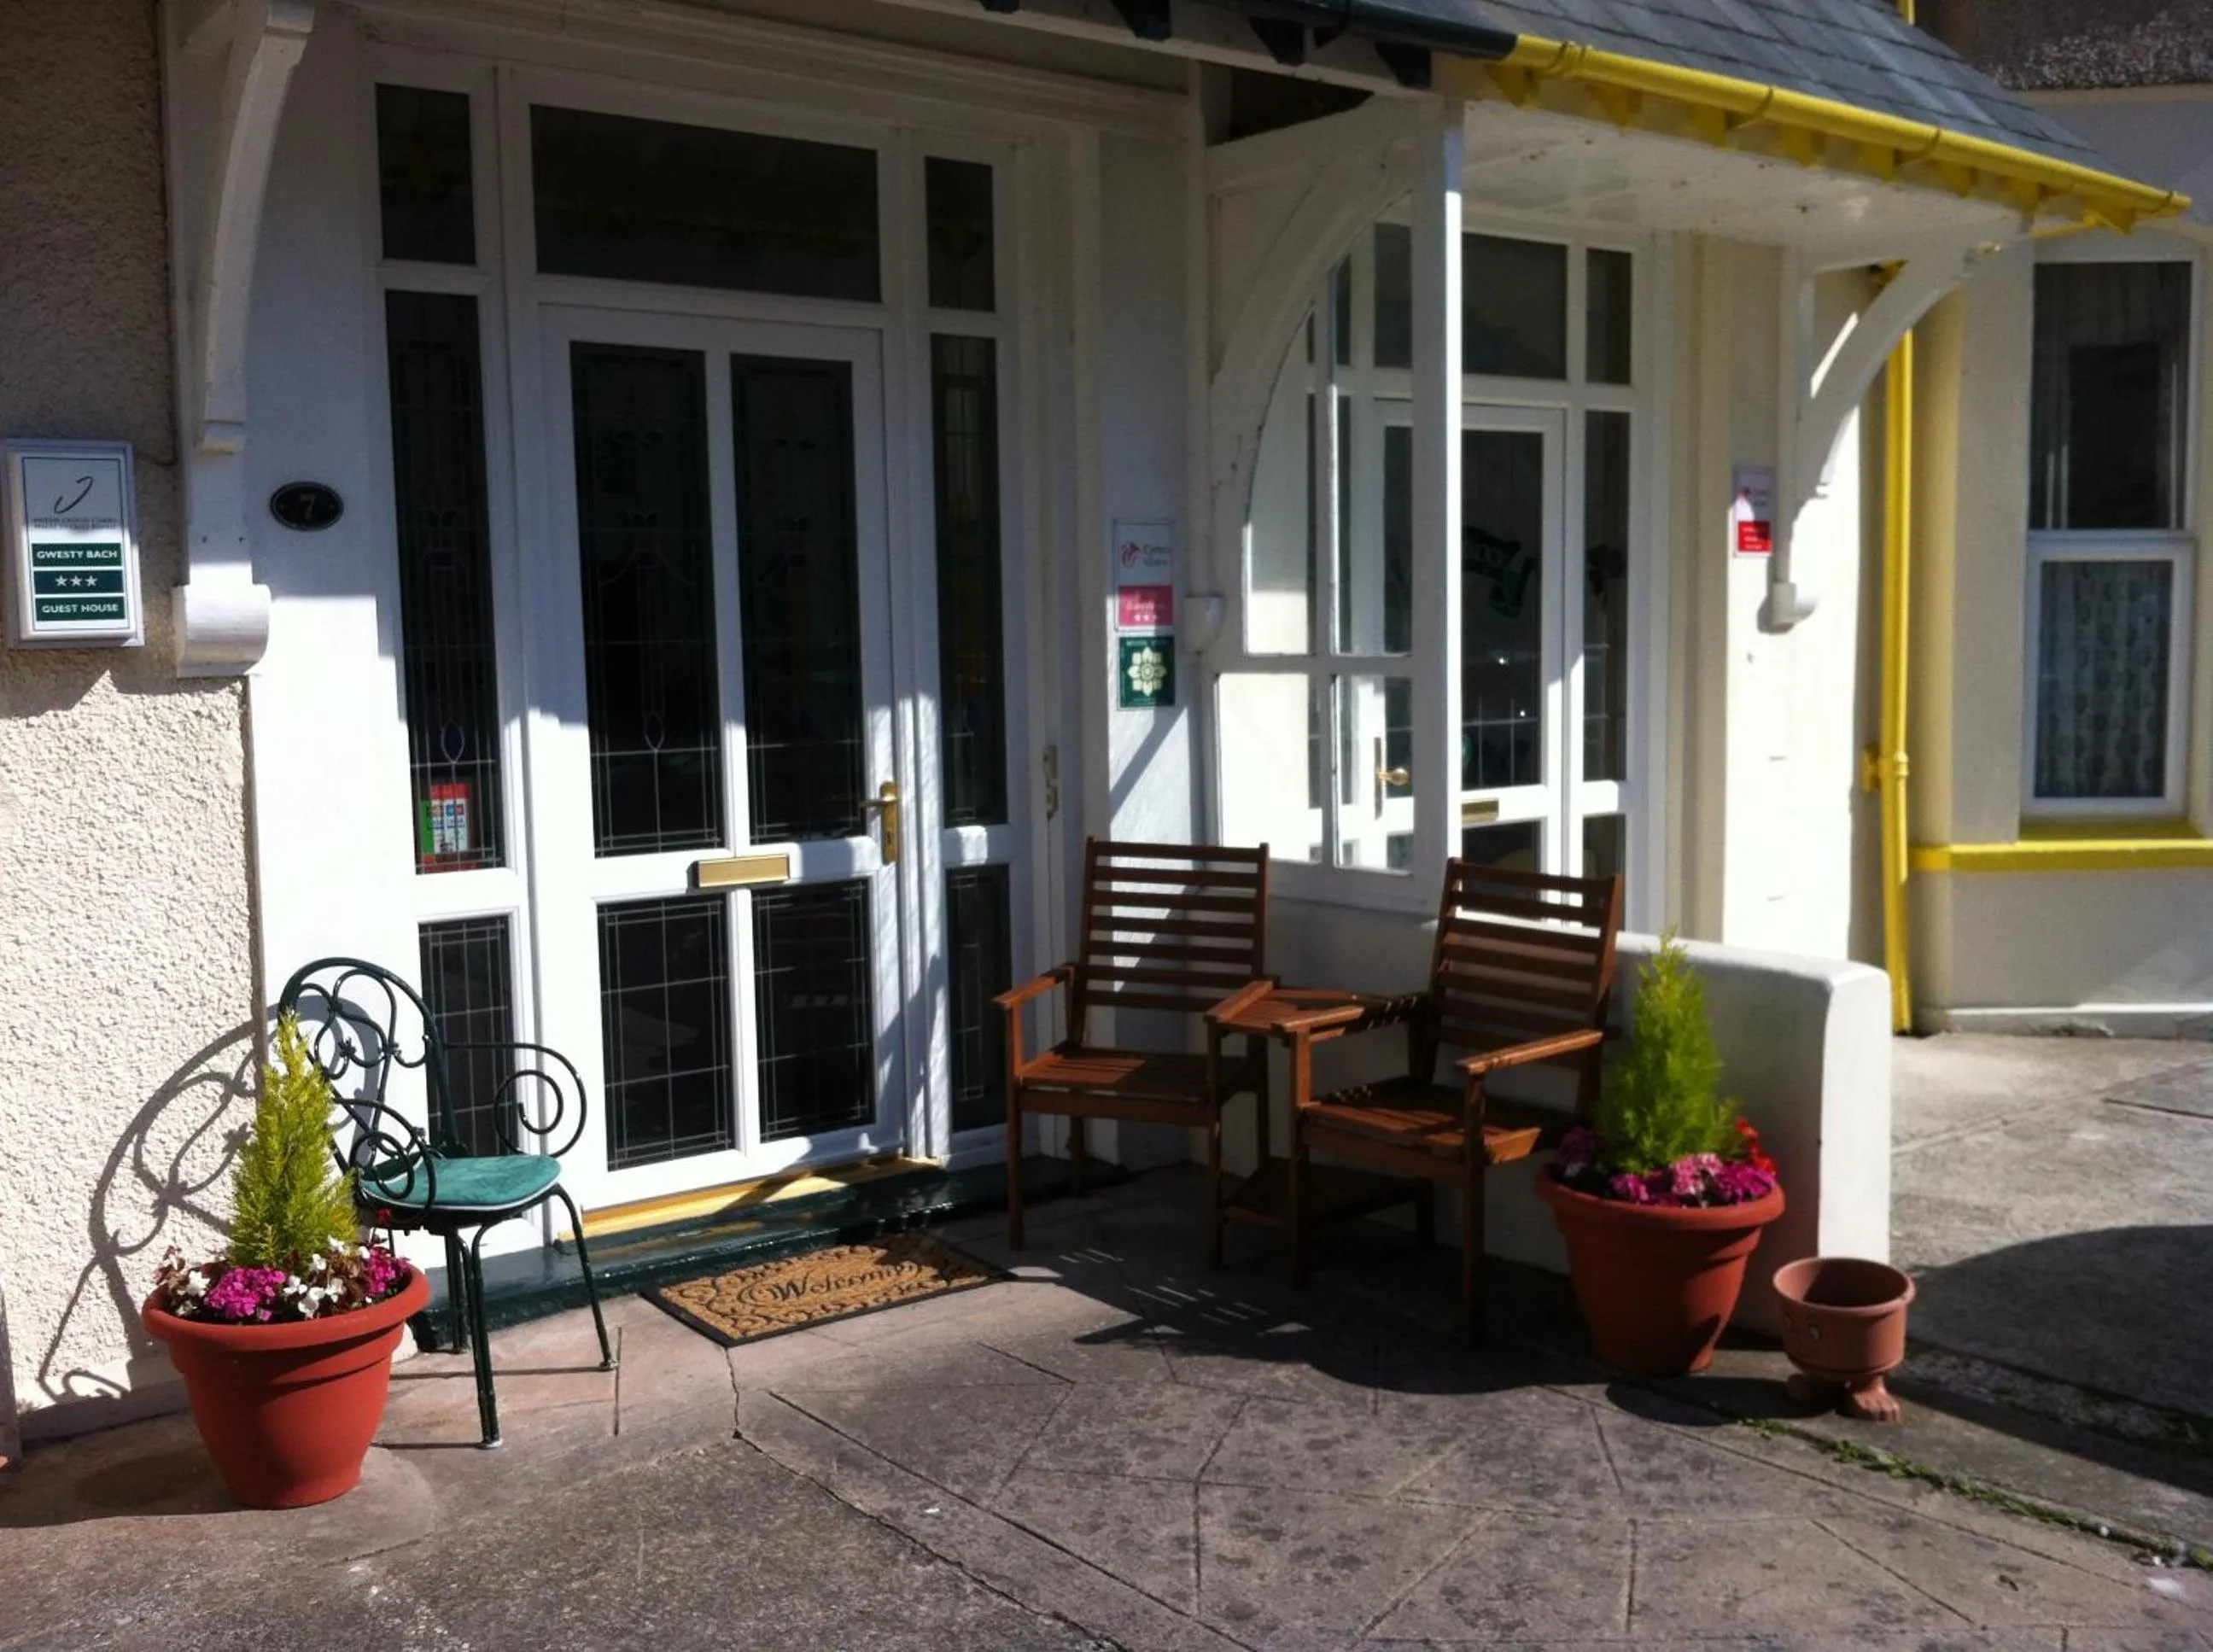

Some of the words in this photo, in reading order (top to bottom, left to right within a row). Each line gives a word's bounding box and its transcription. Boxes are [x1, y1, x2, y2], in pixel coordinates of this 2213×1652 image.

[300, 494, 316, 521] 7
[37, 550, 84, 559] GWESTY
[86, 550, 118, 559] BACH
[41, 604, 78, 613] GUEST
[80, 603, 119, 612] HOUSE
